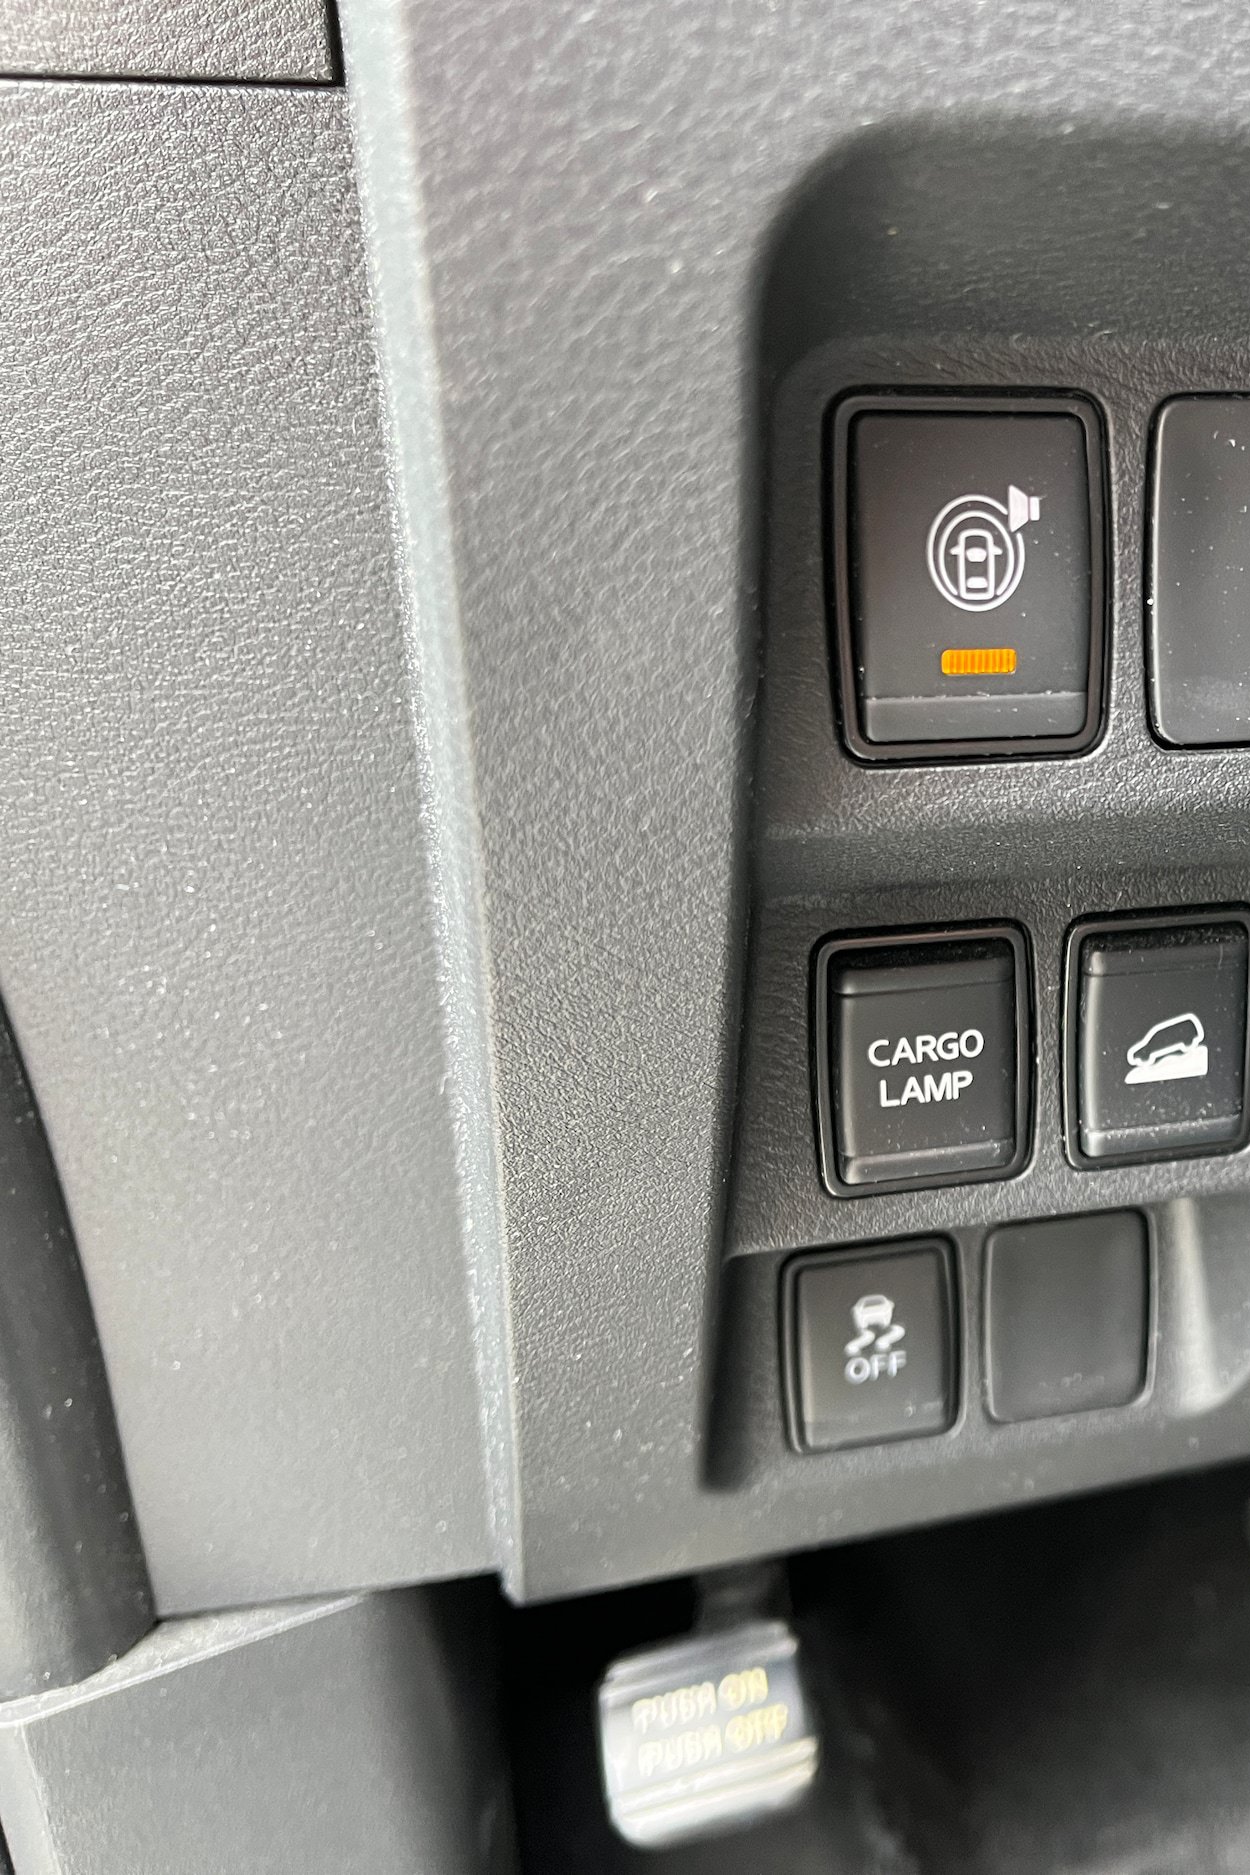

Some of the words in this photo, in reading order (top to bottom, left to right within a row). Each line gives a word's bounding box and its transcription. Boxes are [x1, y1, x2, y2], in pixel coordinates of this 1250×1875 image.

[868, 1029, 984, 1067] CARGO
[879, 1070, 973, 1107] LAMP
[845, 1350, 907, 1384] OFF
